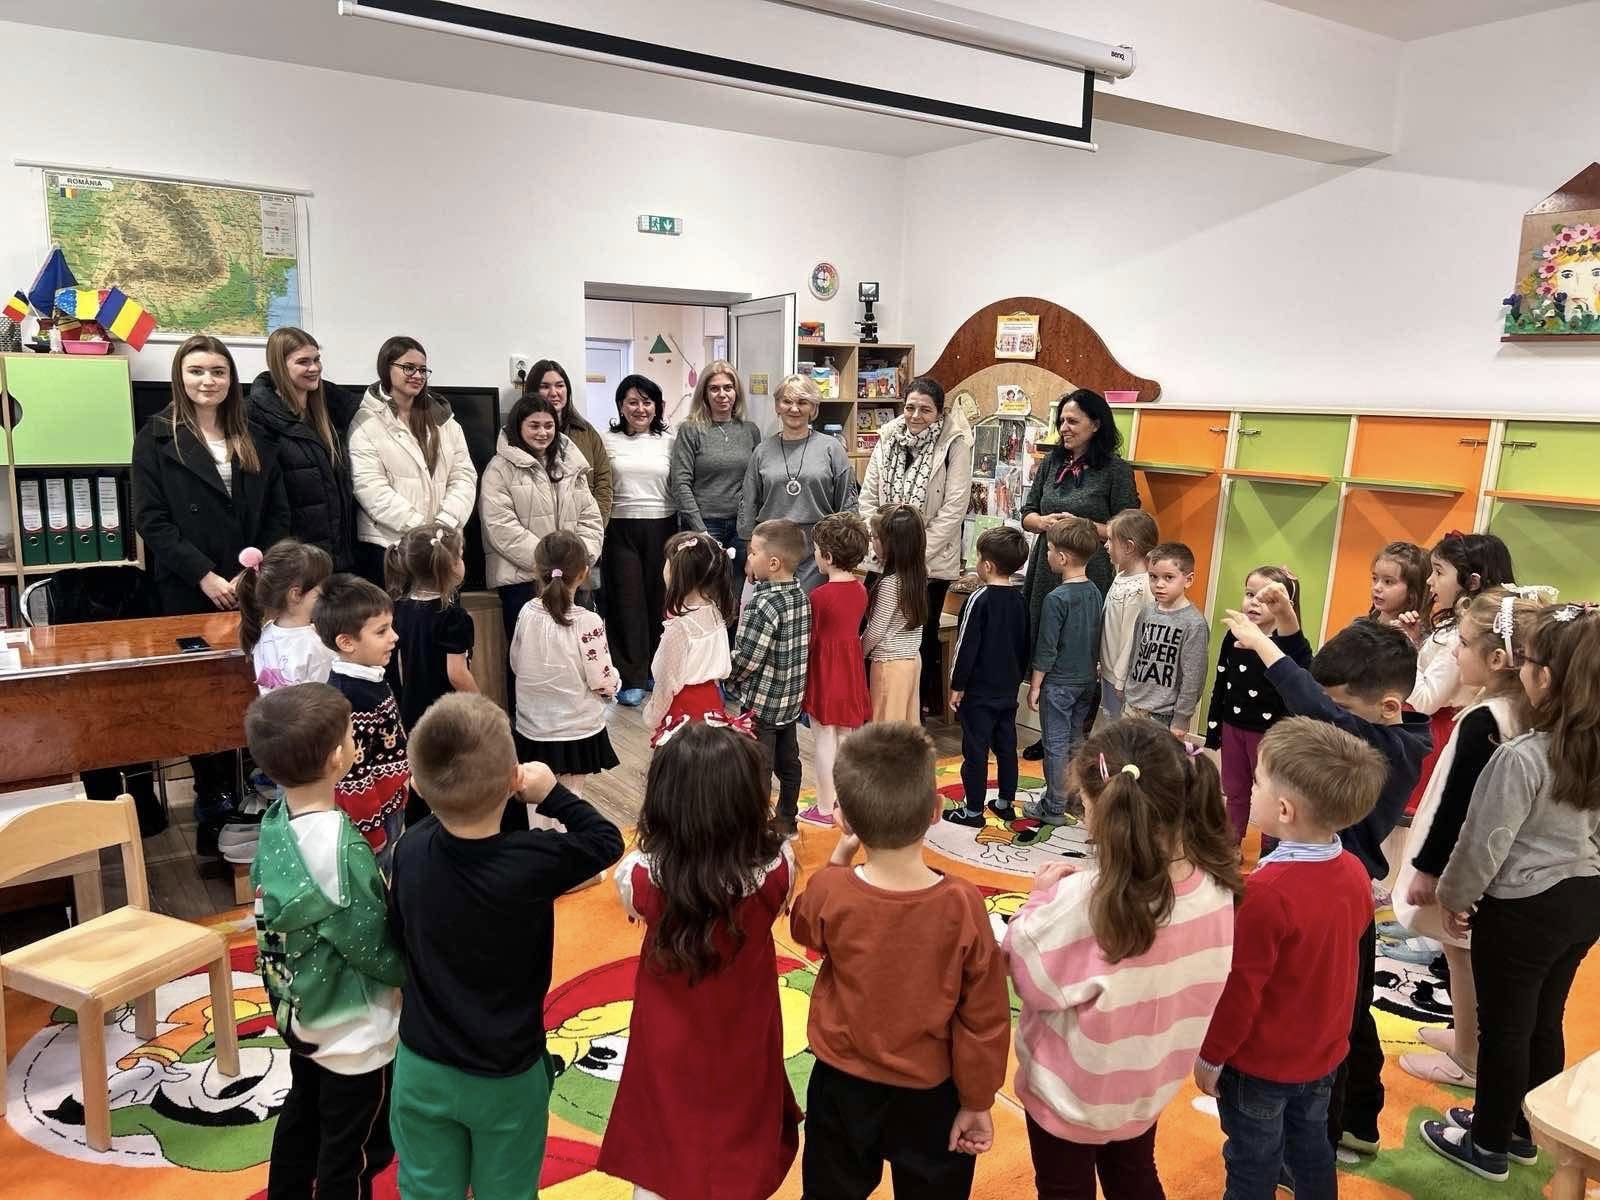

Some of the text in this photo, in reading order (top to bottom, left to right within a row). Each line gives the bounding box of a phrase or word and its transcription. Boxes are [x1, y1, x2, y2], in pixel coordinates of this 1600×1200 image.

[67, 177, 103, 187] ROMÂNIA
[1139, 642, 1177, 664] SUPER
[1132, 660, 1174, 688] STAR
